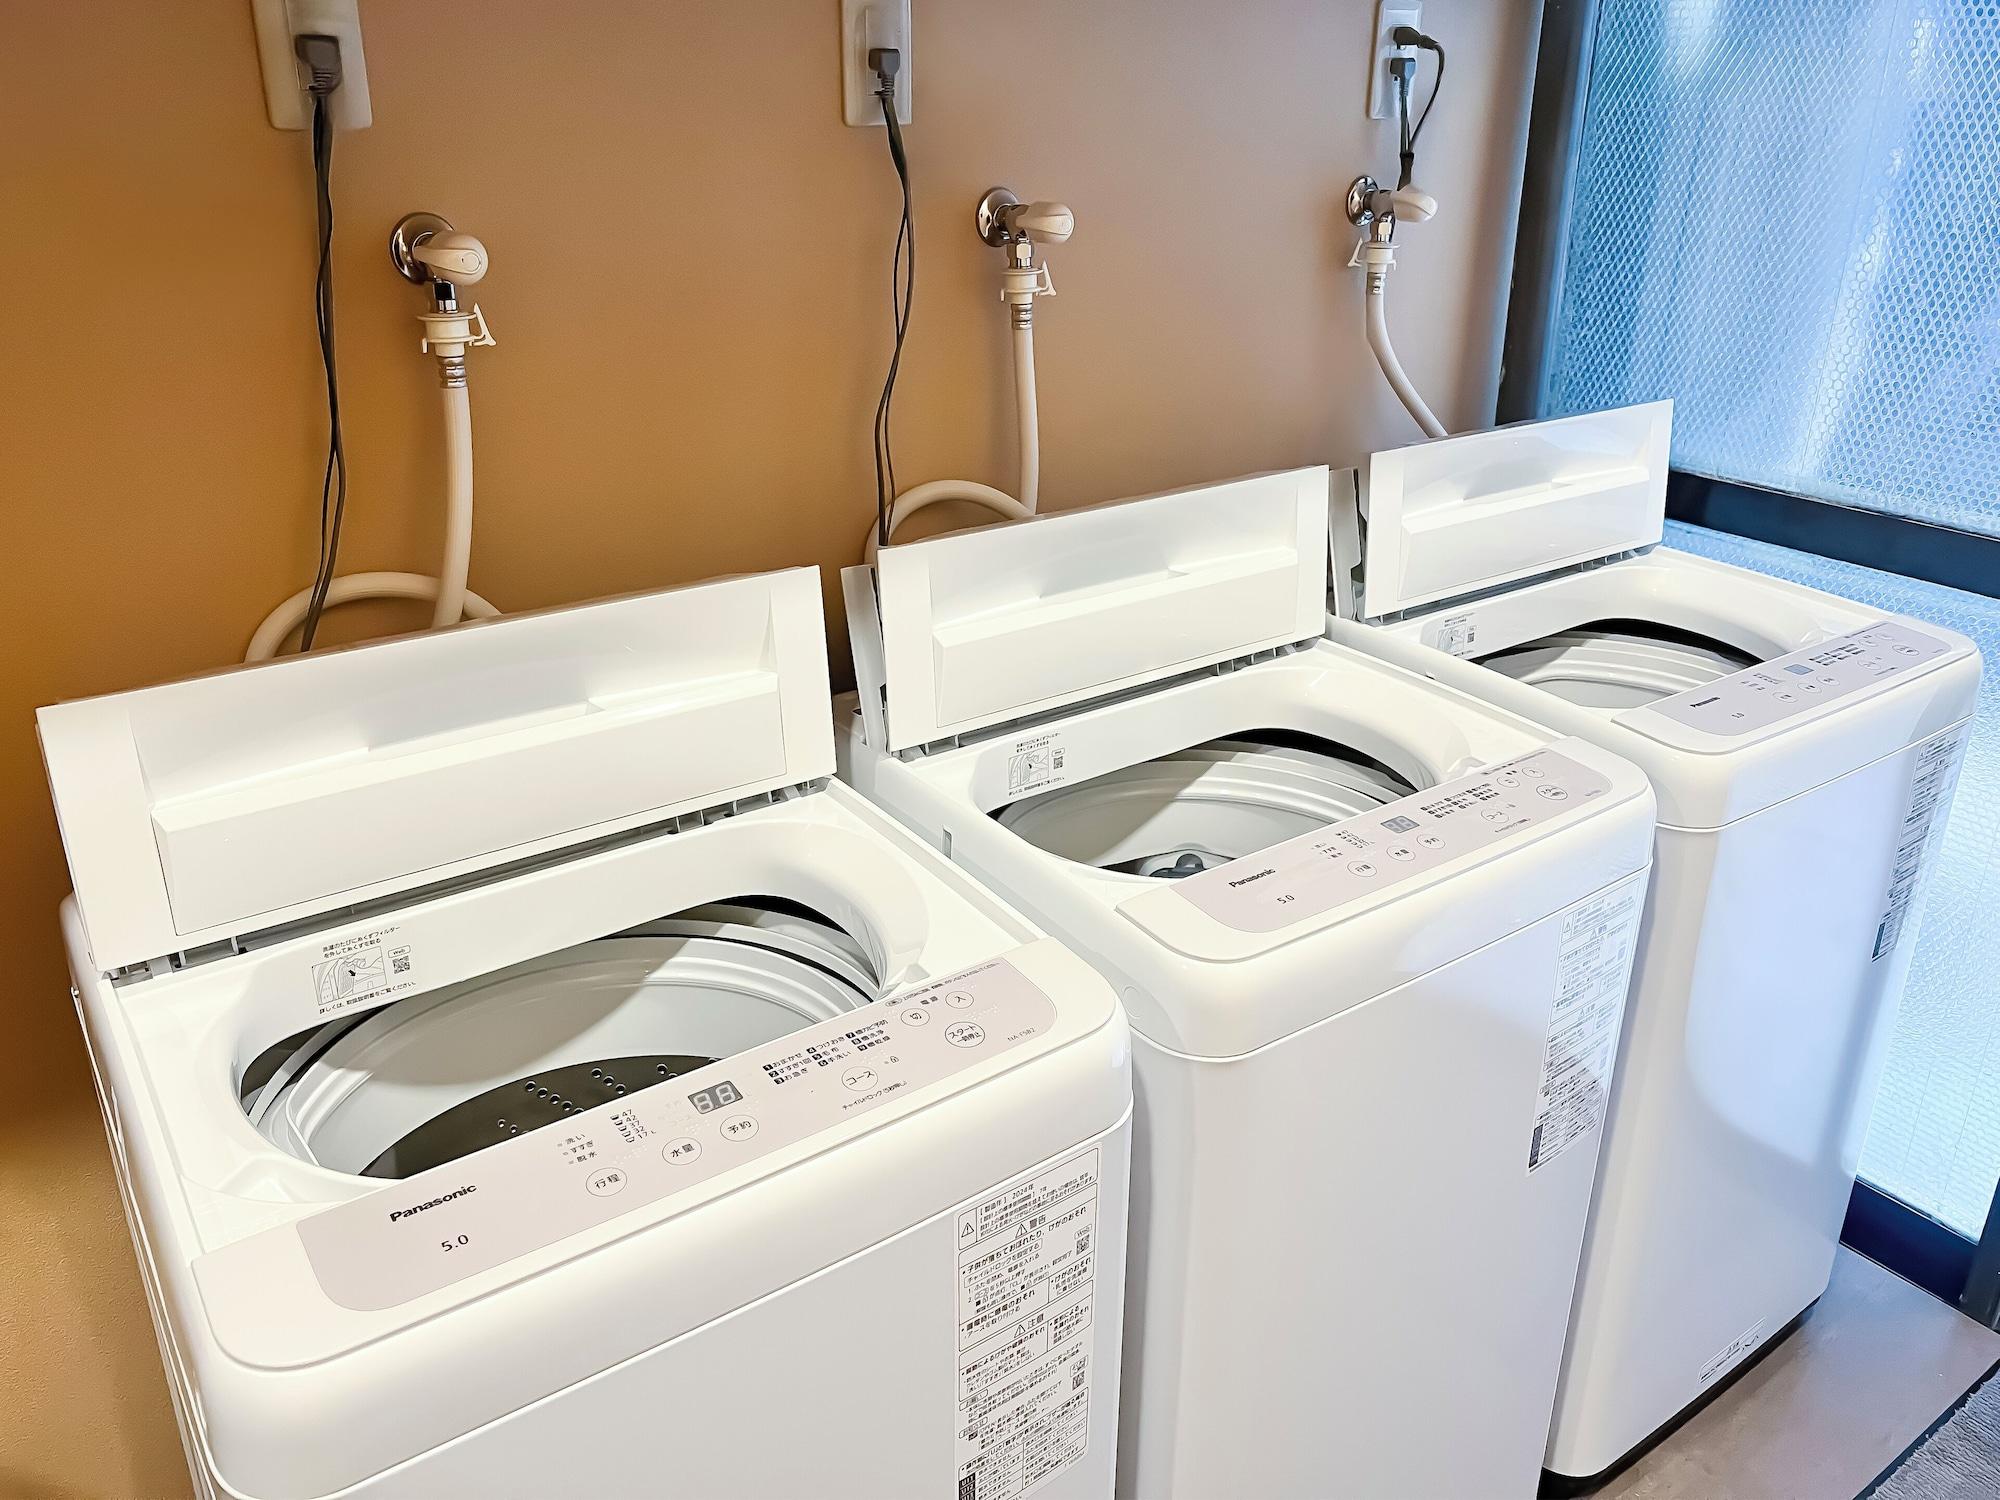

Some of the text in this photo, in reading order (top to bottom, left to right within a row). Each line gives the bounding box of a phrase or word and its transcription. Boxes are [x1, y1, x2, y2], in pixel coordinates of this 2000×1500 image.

[1228, 867, 1276, 888] Panasonic
[1276, 894, 1295, 905] 5.0
[909, 1012, 923, 1021] 切
[947, 1024, 977, 1040] スタート
[845, 1069, 875, 1086] コース
[621, 1108, 634, 1118] 47
[625, 1114, 637, 1123] 42
[629, 1120, 641, 1129] 37
[633, 1125, 645, 1134] 32
[727, 1120, 752, 1135] 予約
[570, 1139, 595, 1154] すすぎ
[671, 1142, 696, 1158] 水量
[576, 1150, 598, 1163] 脱水
[594, 1172, 622, 1190] 行程
[389, 1183, 478, 1223] Panasonic
[440, 1232, 470, 1253] 5.0
